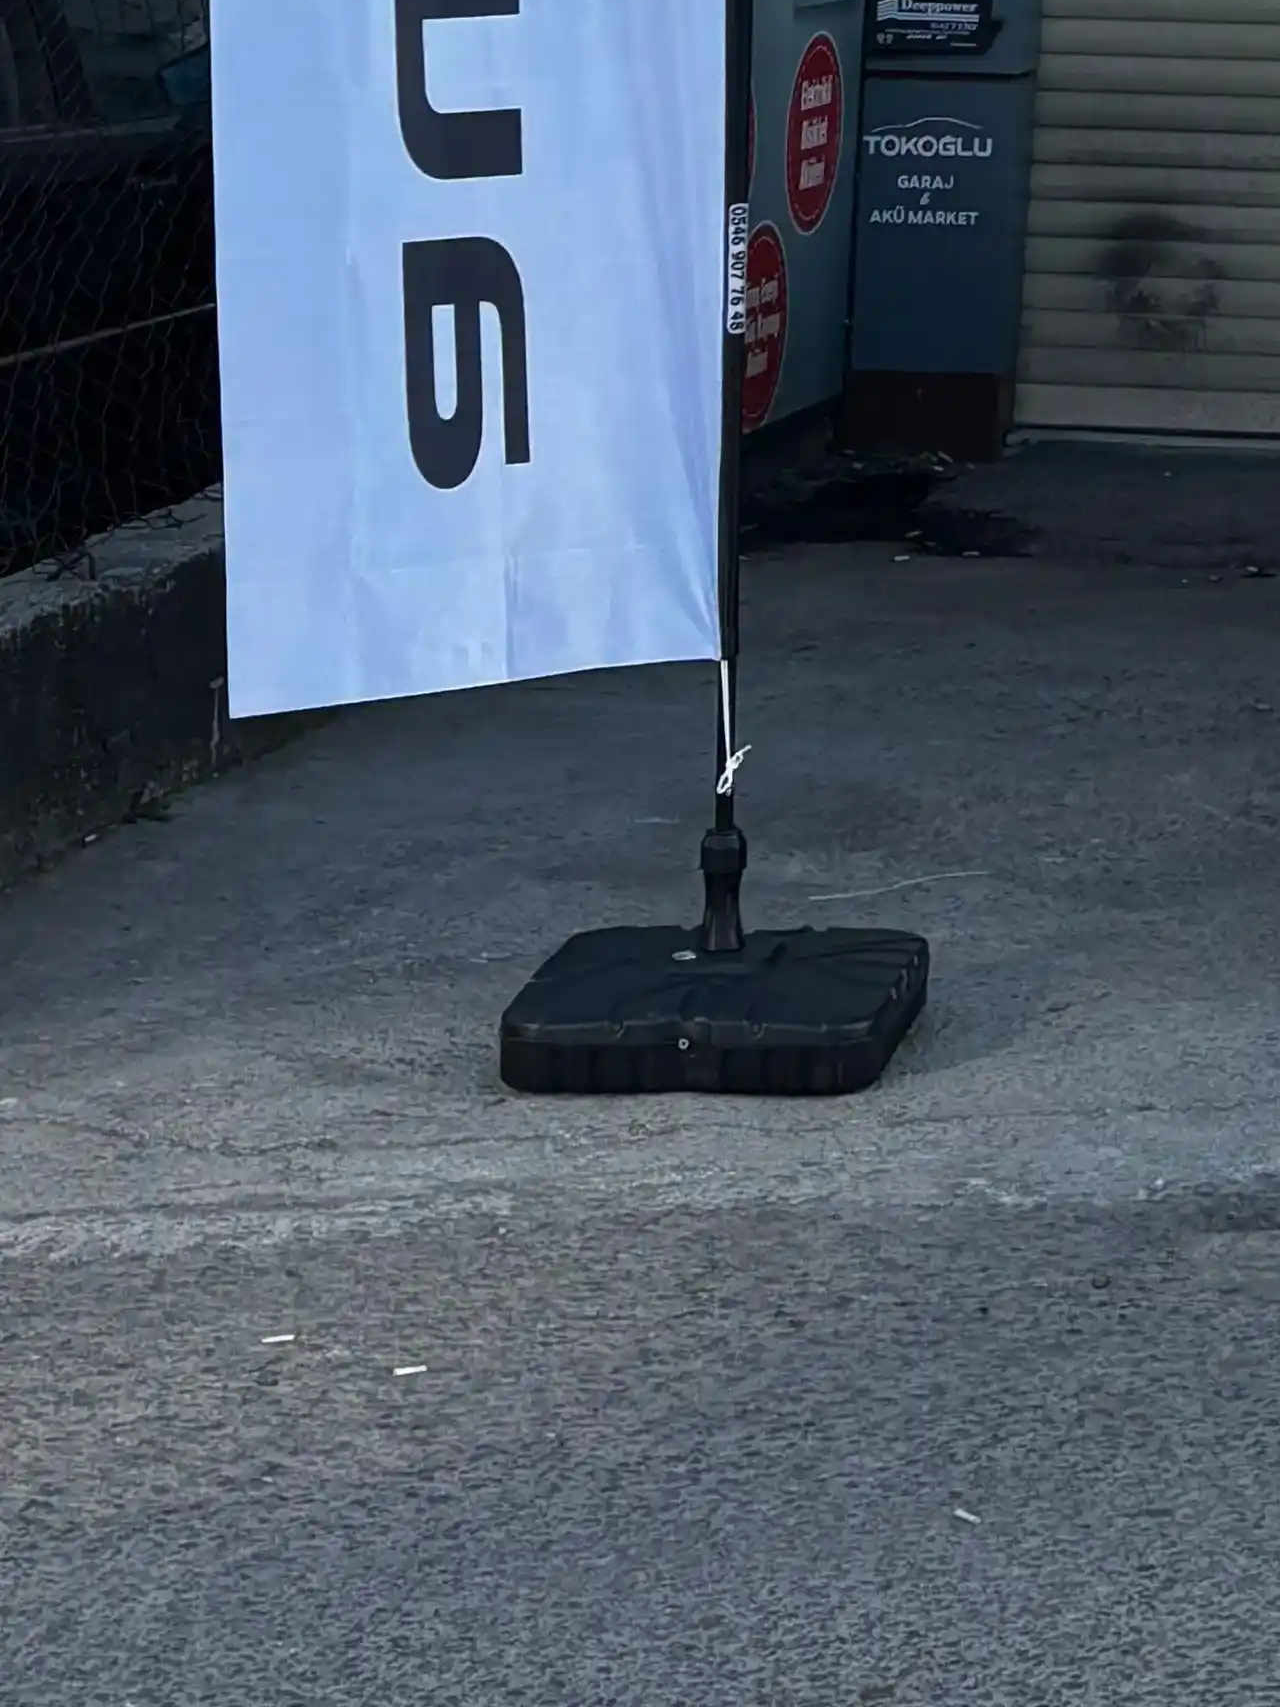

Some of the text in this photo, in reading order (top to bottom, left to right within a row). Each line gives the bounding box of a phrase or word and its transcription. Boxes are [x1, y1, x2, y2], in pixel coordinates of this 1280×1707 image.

[897, 174, 954, 189] GARAJ
[869, 205, 979, 225] AKÜ MARKET
[729, 206, 747, 331] 0546 907 76 48
